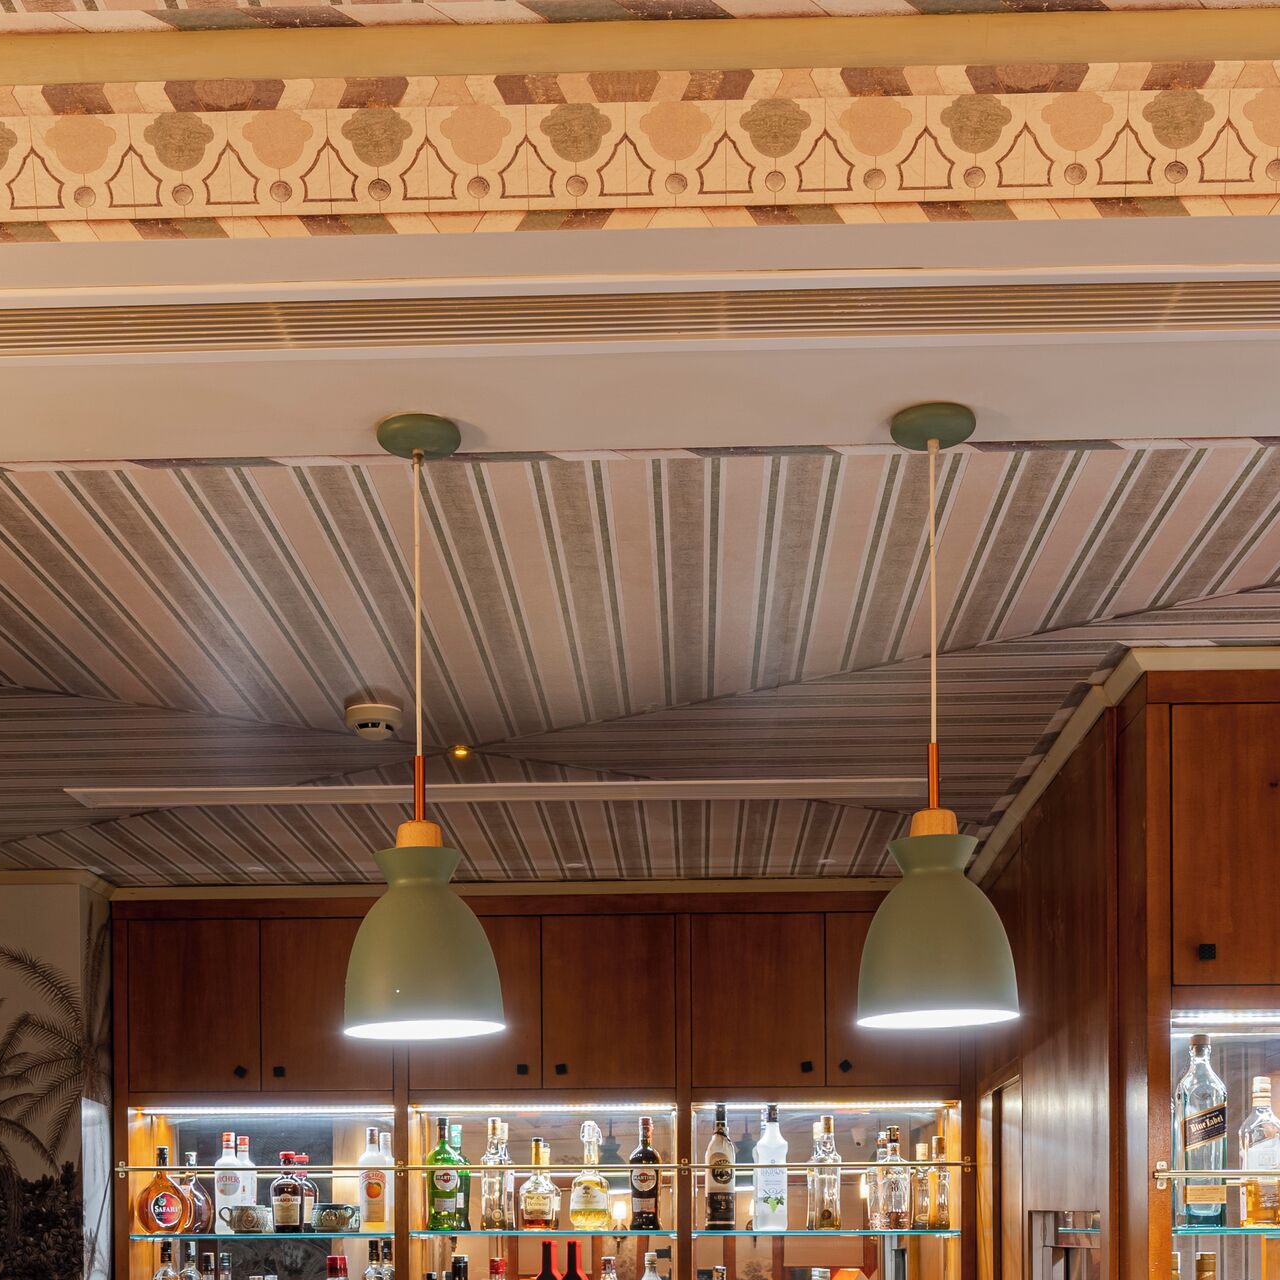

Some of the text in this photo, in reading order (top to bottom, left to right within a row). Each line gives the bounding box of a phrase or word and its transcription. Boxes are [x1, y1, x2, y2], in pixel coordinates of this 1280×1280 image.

[1190, 1120, 1206, 1133] Blue
[1206, 1114, 1224, 1127] Label
[154, 1204, 178, 1213] SAFARI
